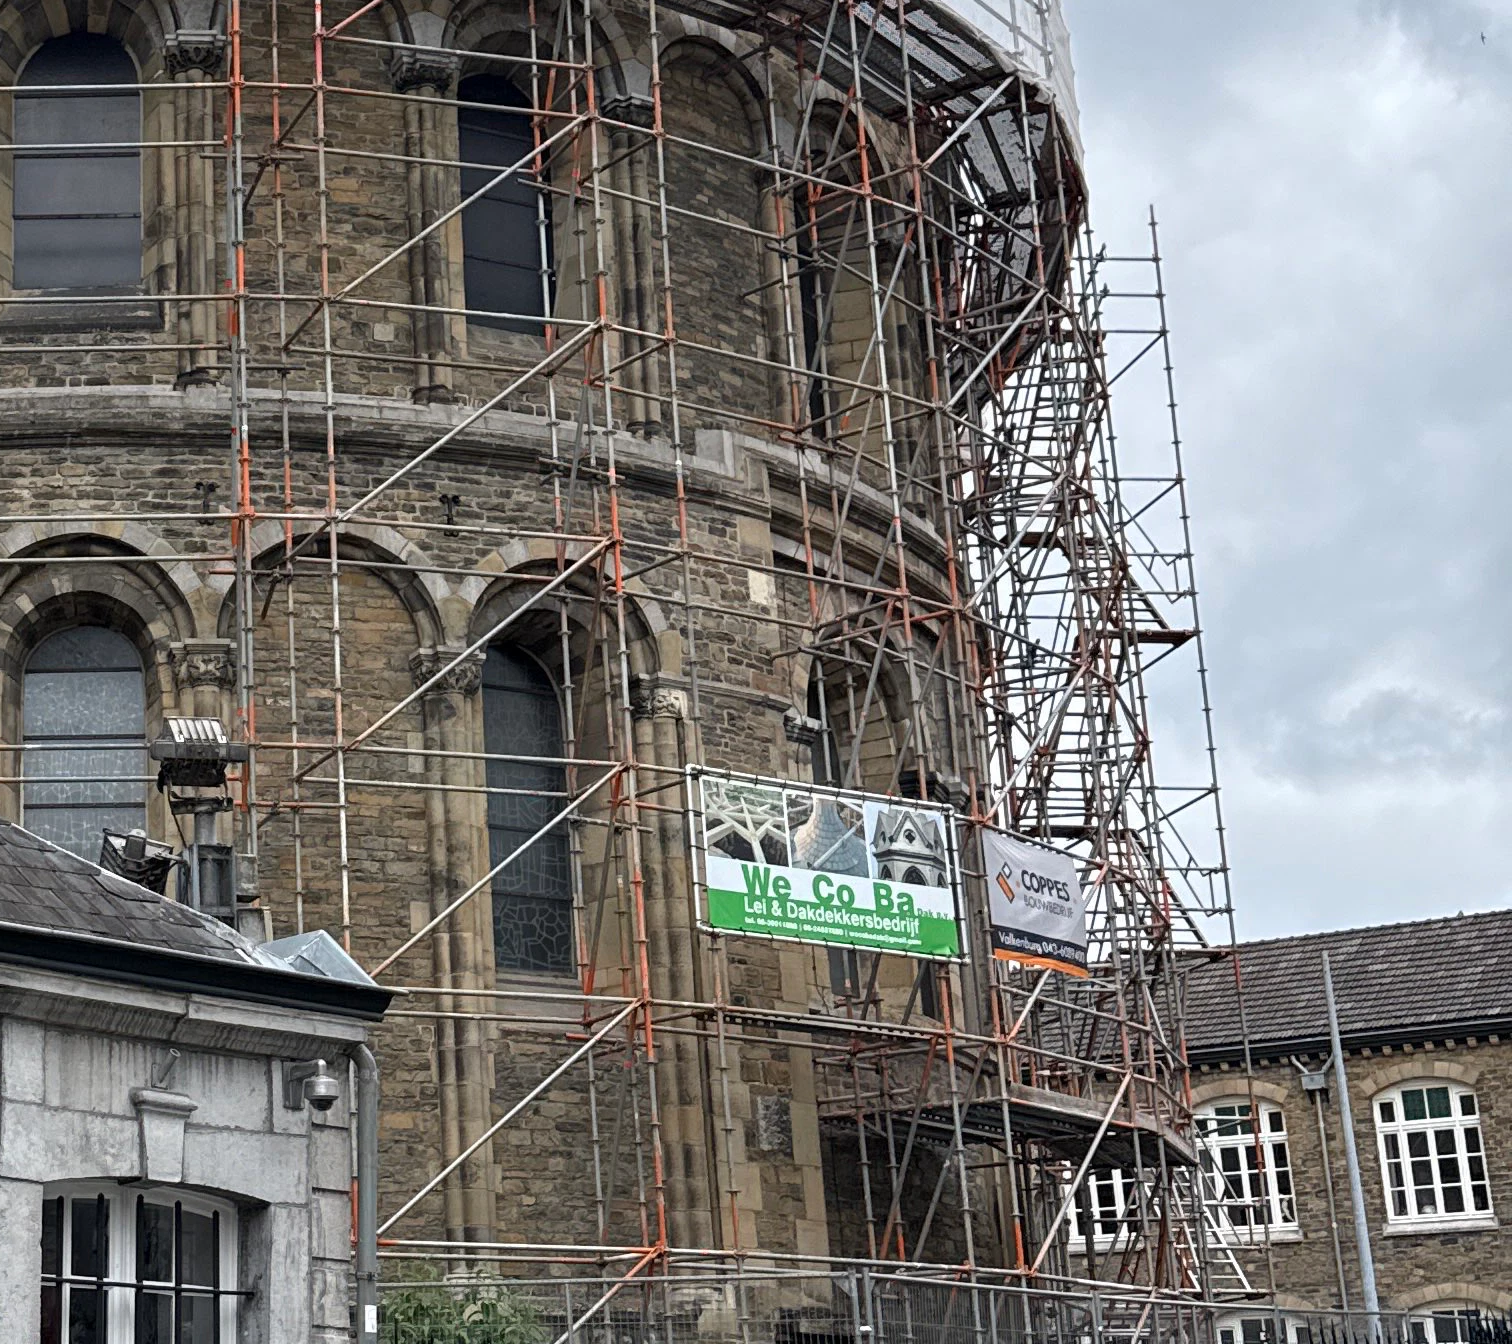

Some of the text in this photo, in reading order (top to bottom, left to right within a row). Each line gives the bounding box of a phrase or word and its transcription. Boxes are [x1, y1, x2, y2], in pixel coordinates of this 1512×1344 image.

[741, 864, 792, 900] We
[812, 873, 856, 910] Co
[872, 881, 917, 917] Ba
[1021, 869, 1070, 902] COPPES
[744, 895, 767, 915] Lei
[771, 899, 783, 917] &
[786, 901, 920, 937] Dakdekkersbedrijf
[998, 931, 1043, 954] Valkenburg
